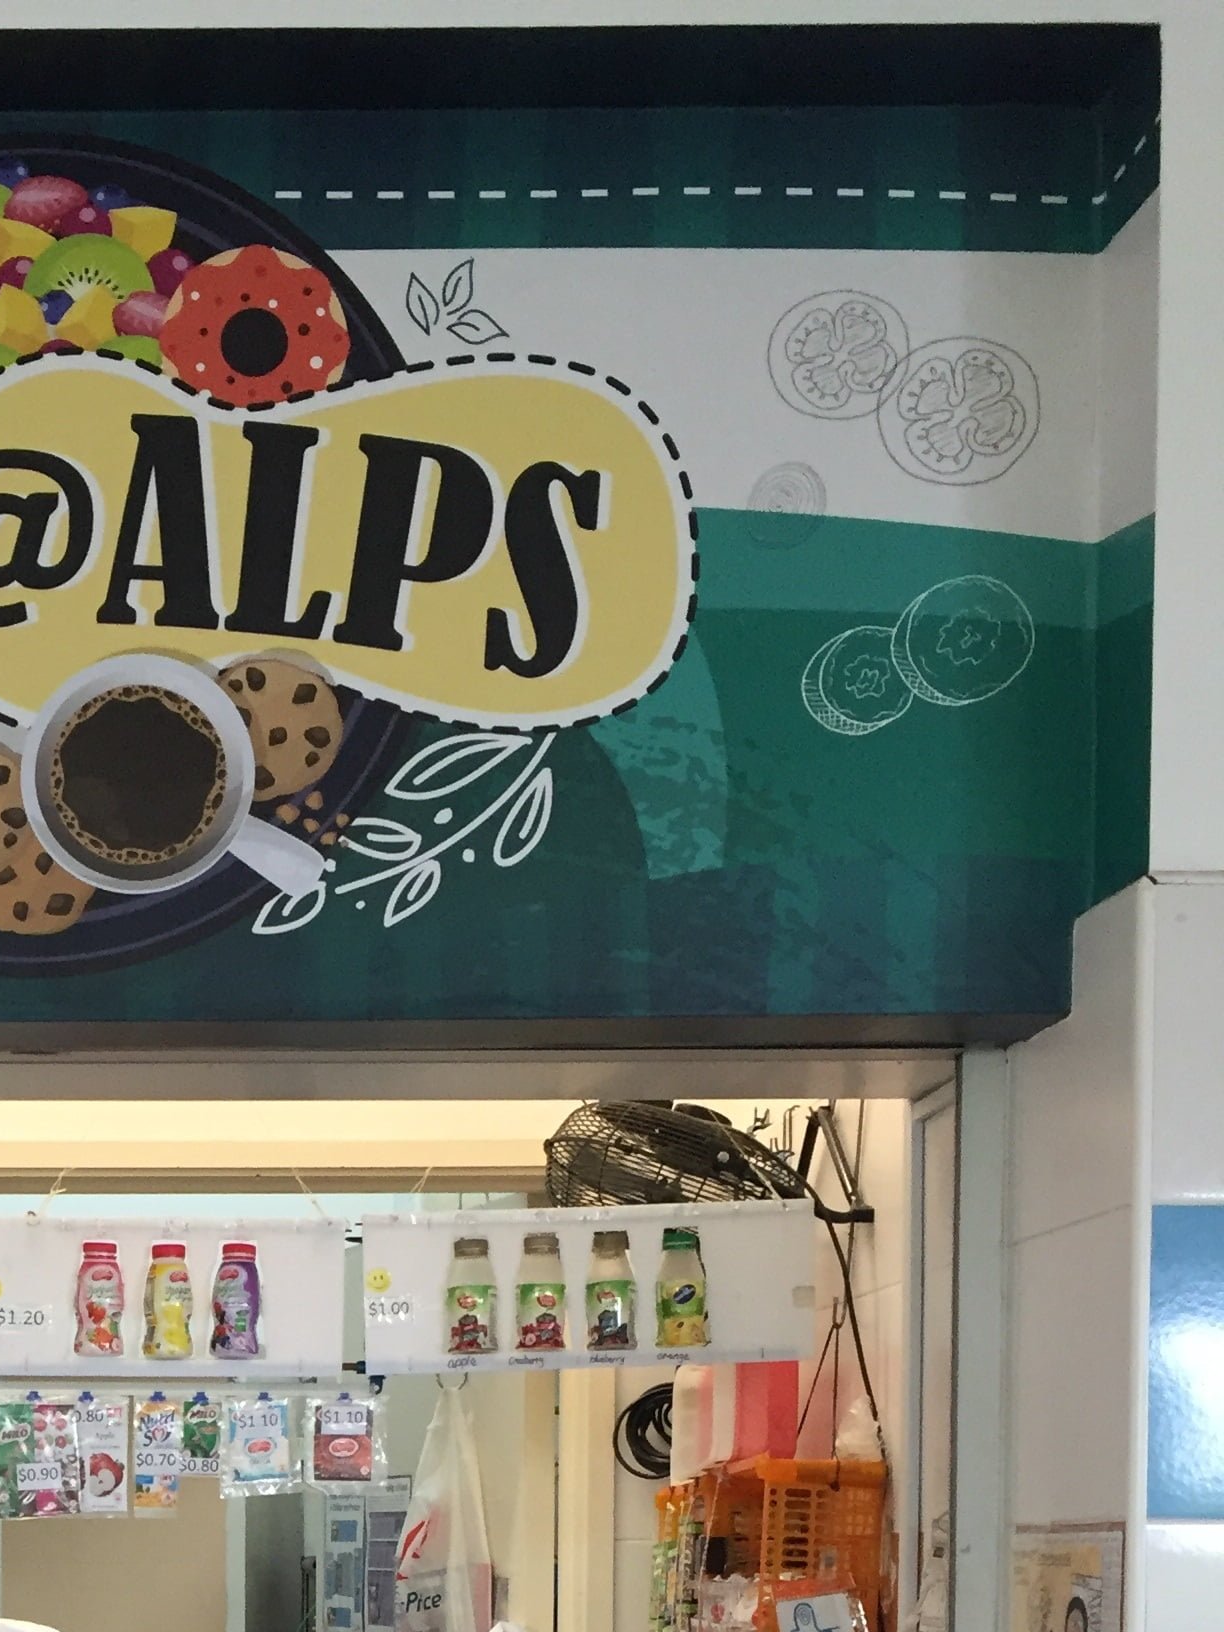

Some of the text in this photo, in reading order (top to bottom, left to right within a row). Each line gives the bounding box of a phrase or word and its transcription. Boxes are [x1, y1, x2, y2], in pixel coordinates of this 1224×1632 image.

[369, 1301, 410, 1317] $1.00
[447, 1358, 477, 1369] apple
[188, 1409, 218, 1419] MILO
[323, 1409, 364, 1425] $1.10
[0, 1427, 30, 1441] MILO
[136, 1452, 177, 1468] $0.70
[178, 1456, 220, 1474] $0.80
[18, 1466, 60, 1484] $0.90
